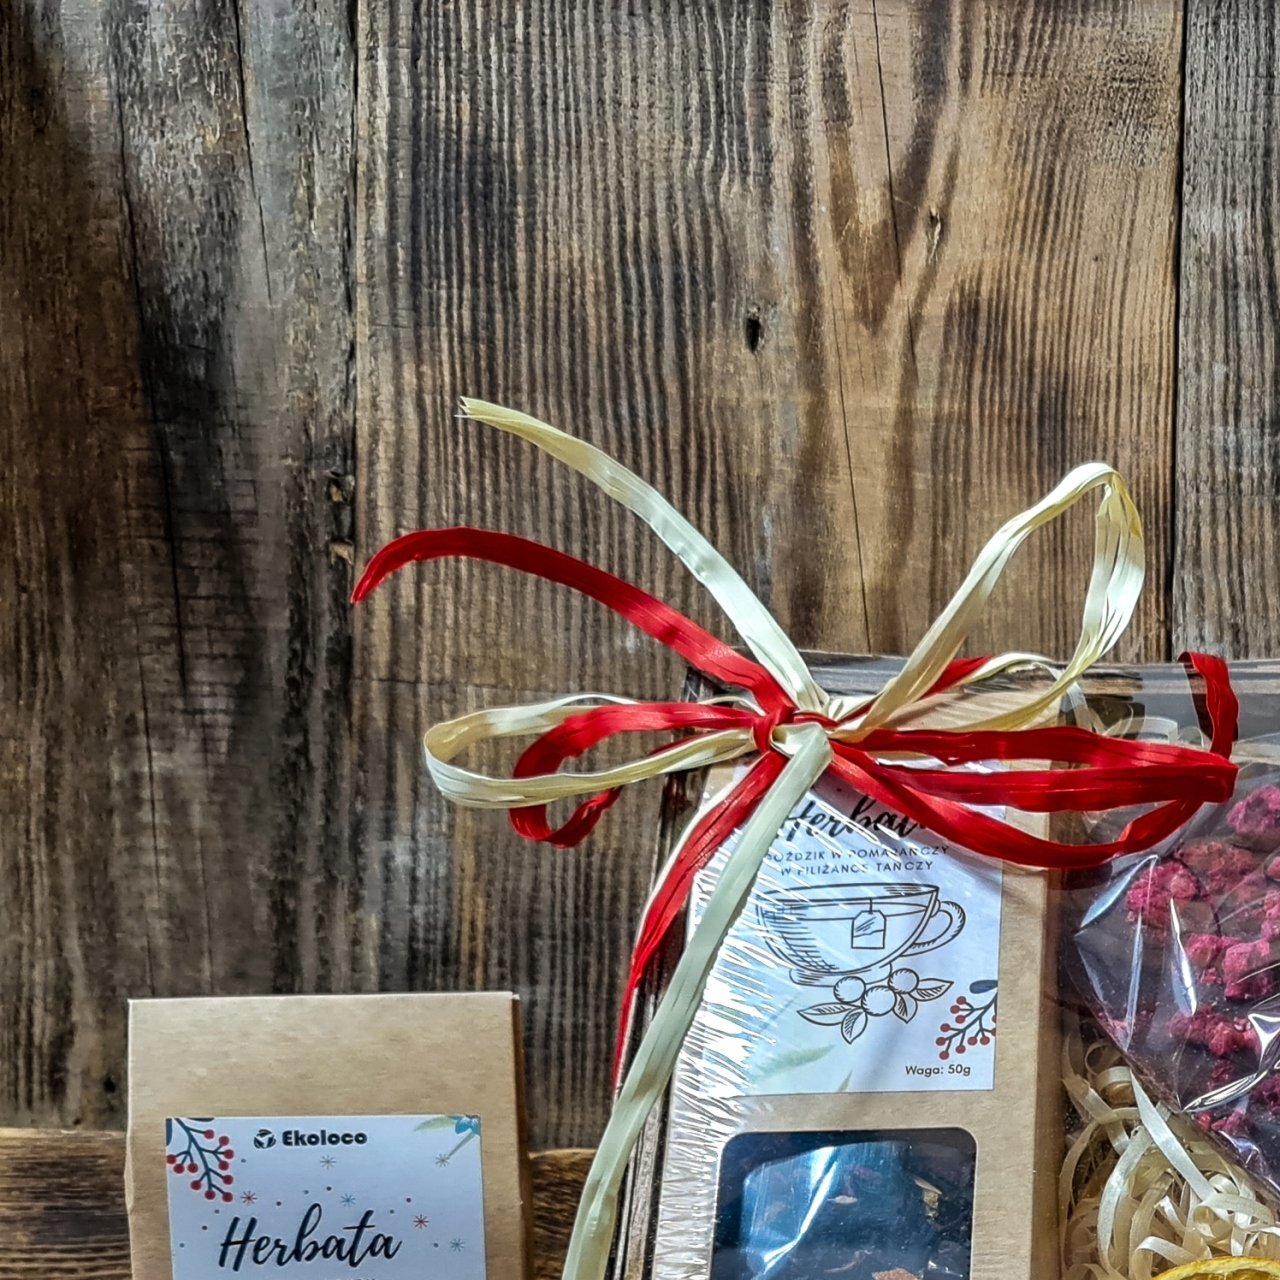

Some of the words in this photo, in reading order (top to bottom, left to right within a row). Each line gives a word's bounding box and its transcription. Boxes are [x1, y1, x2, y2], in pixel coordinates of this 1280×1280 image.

[905, 1065, 944, 1078] Waga:
[947, 1064, 972, 1077] 50g
[281, 1129, 368, 1148] Ekoloco
[218, 1203, 403, 1272] Herbata
